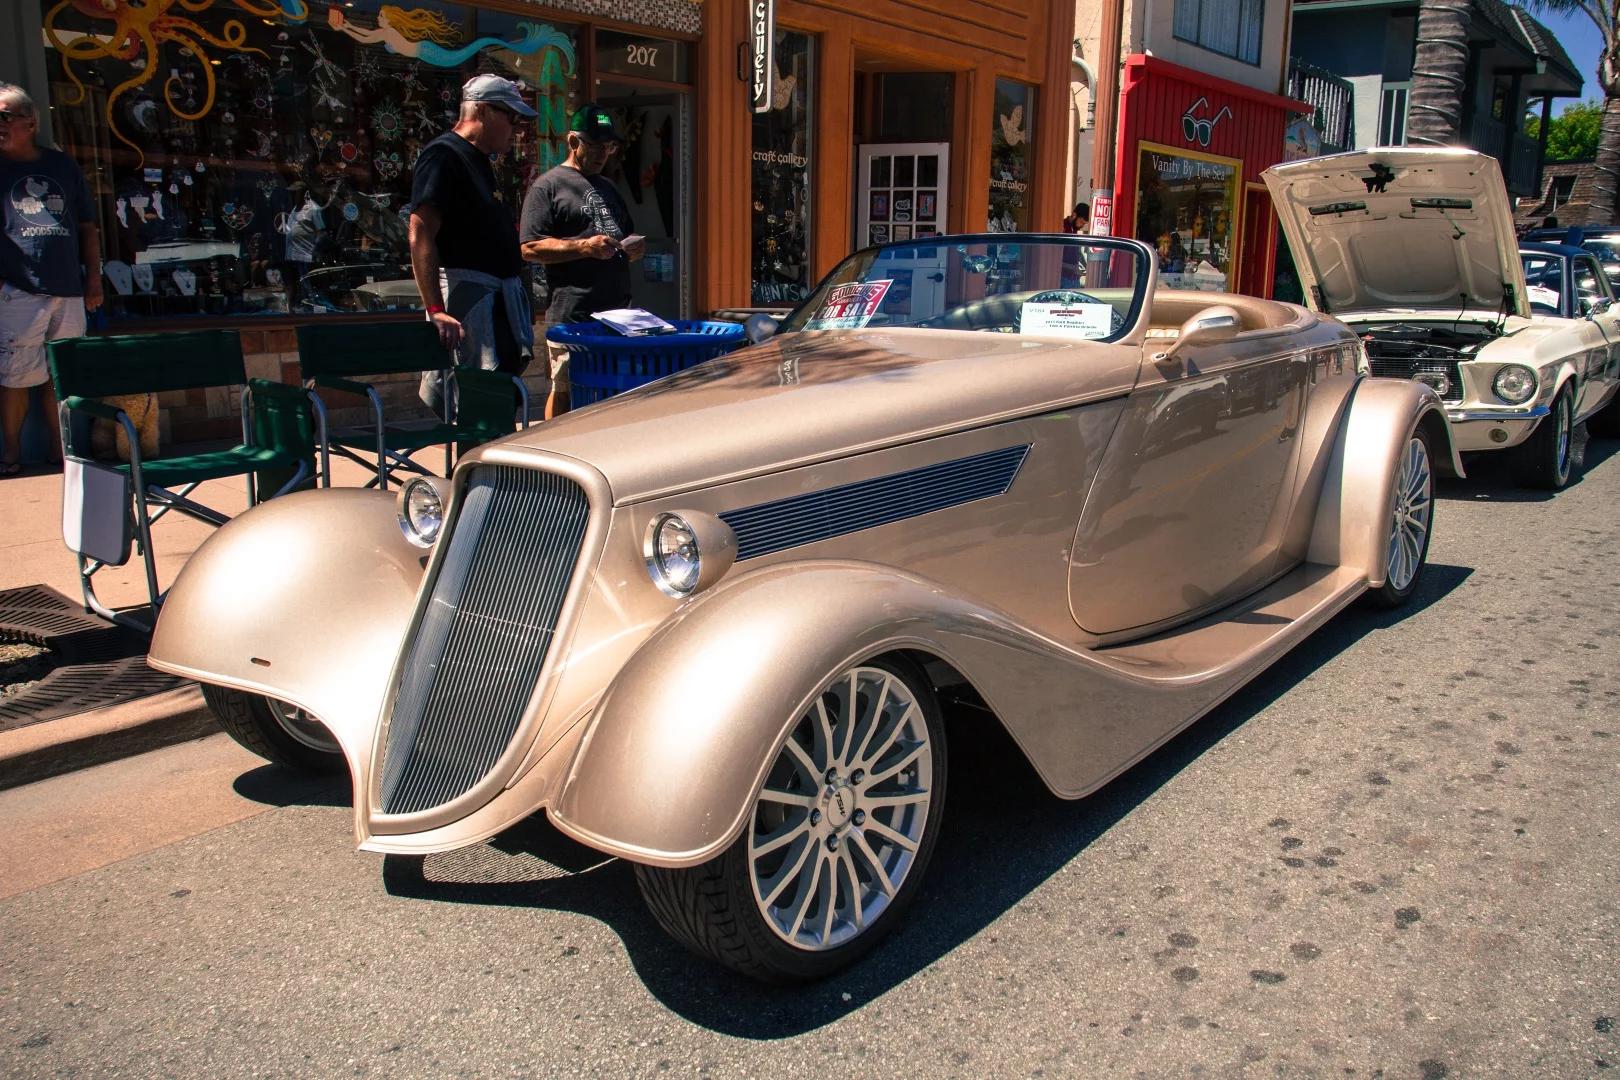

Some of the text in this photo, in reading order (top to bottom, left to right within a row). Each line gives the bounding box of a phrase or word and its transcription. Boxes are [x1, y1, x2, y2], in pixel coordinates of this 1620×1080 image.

[627, 44, 658, 67] 207
[752, 150, 809, 168] craft gallery
[1152, 155, 1225, 180] Vanity By The Sea
[1096, 204, 1109, 217] NO
[20, 226, 70, 237] WOODSTOCK
[817, 301, 874, 319] FOR SALE
[835, 792, 846, 817] TSW
